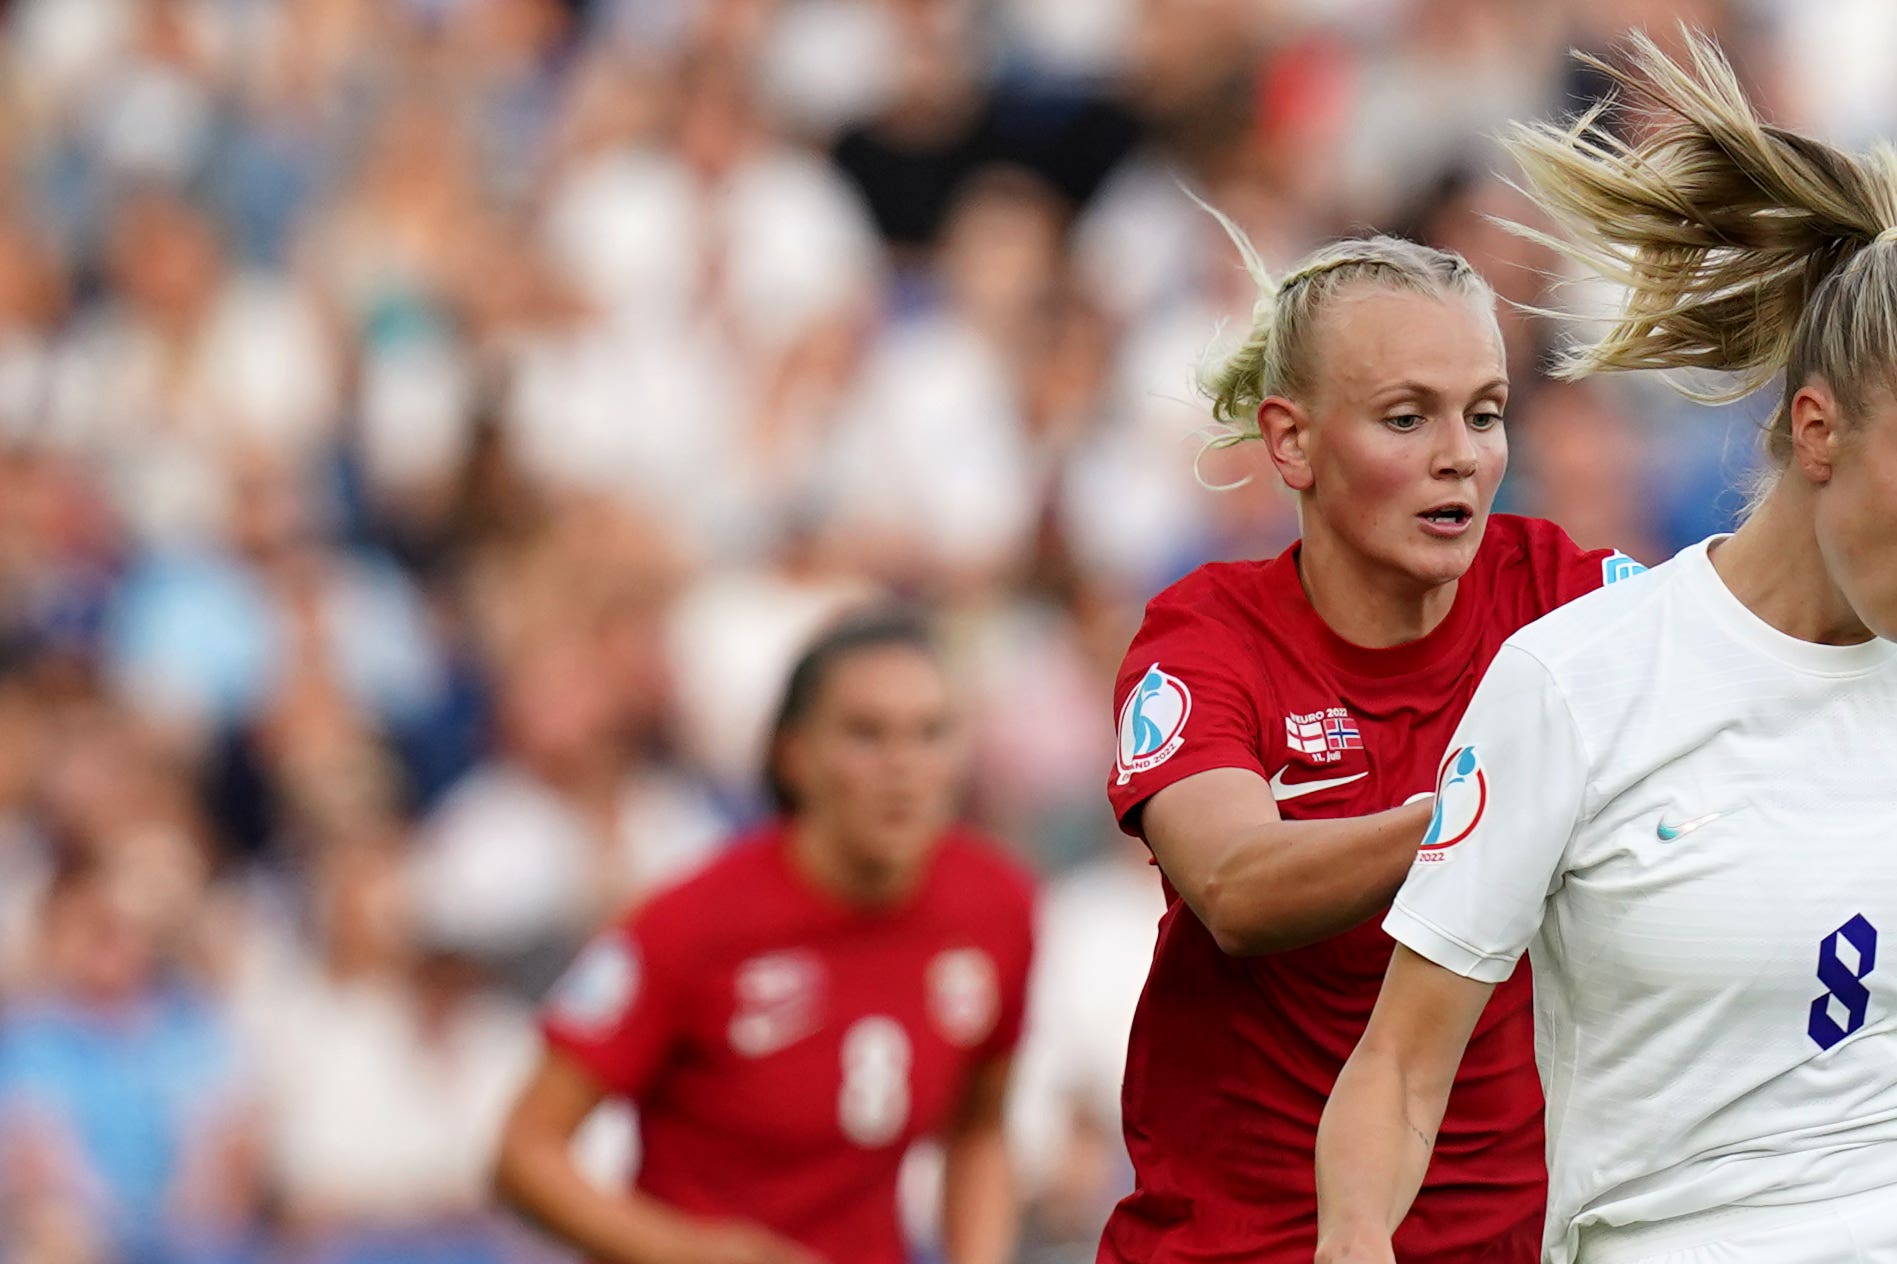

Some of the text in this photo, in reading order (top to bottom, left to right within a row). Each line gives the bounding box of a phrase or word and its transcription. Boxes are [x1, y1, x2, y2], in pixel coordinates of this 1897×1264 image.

[1326, 707, 1348, 718] 2022
[1154, 743, 1177, 764] 2022
[1807, 912, 1878, 1051] 8
[838, 1015, 912, 1148] 8
